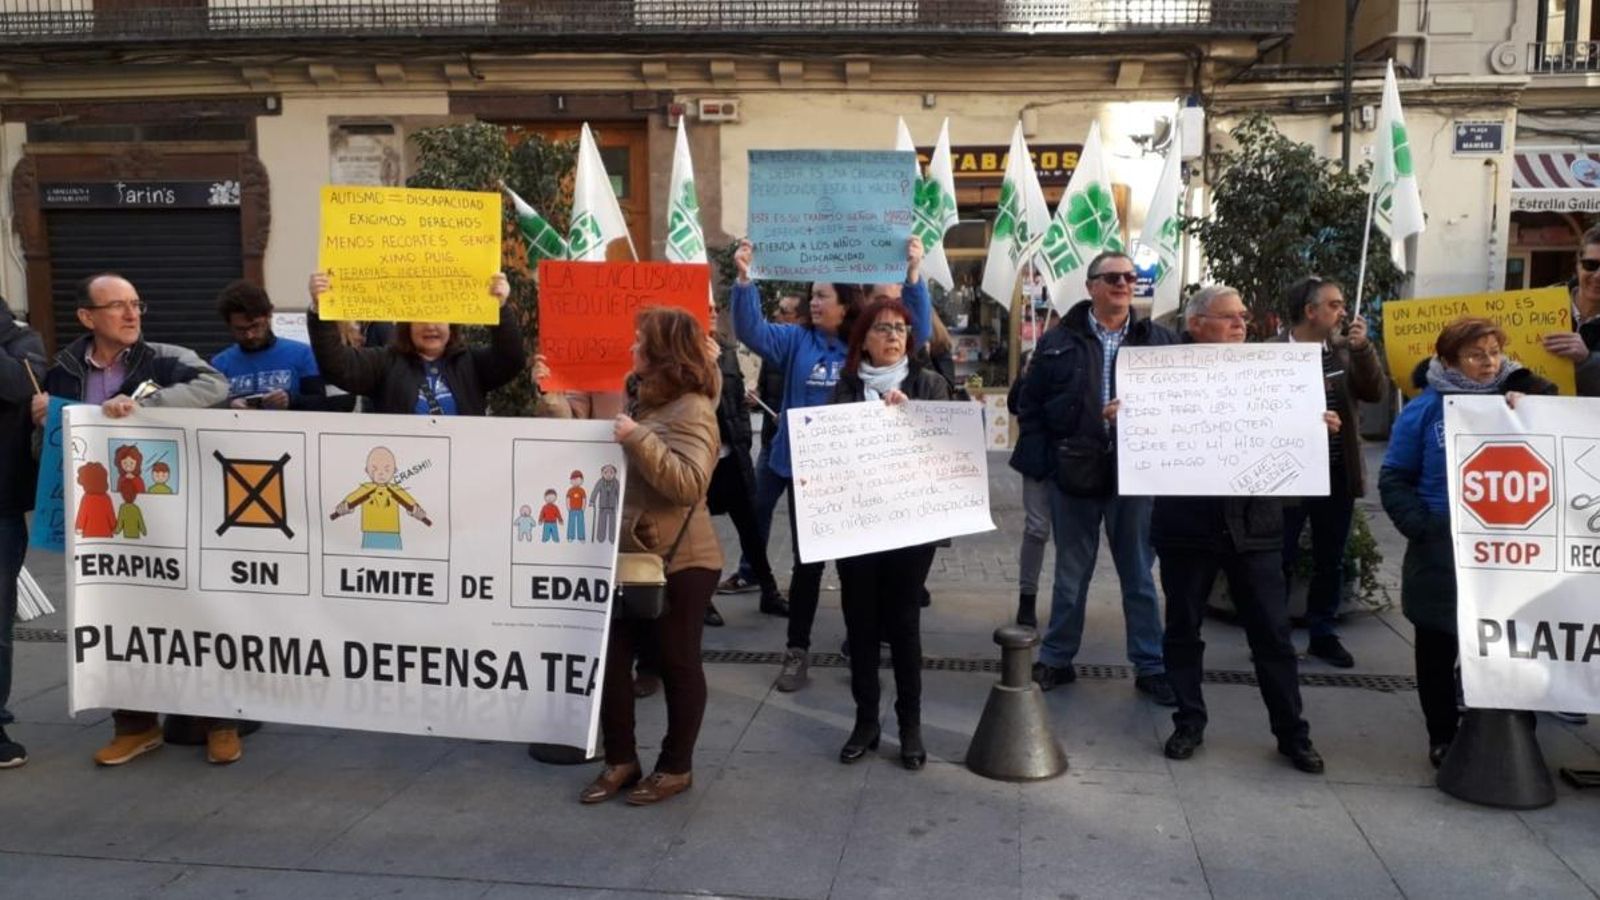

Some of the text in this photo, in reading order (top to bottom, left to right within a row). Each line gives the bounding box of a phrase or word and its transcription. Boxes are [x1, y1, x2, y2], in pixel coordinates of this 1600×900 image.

[330, 191, 384, 205] AUTISMO
[406, 193, 484, 210] DISCAPACIDAD
[1518, 197, 1565, 210] Estrella
[419, 215, 482, 229] DERECHOS
[326, 236, 375, 249] MENOS
[382, 234, 449, 248] RECORTES
[379, 252, 416, 264] XIMO
[545, 265, 574, 289] LA
[1393, 297, 1534, 321] UN AUTISTA NO ES
[1127, 373, 1145, 384] TE
[1464, 470, 1547, 503] STOP
[1474, 541, 1541, 565] STOP
[231, 561, 279, 585] SIN
[461, 575, 494, 600] DE
[531, 576, 609, 603] EDAD
[74, 625, 330, 677] PLATAFORMA
[343, 640, 529, 691] DEFENSA
